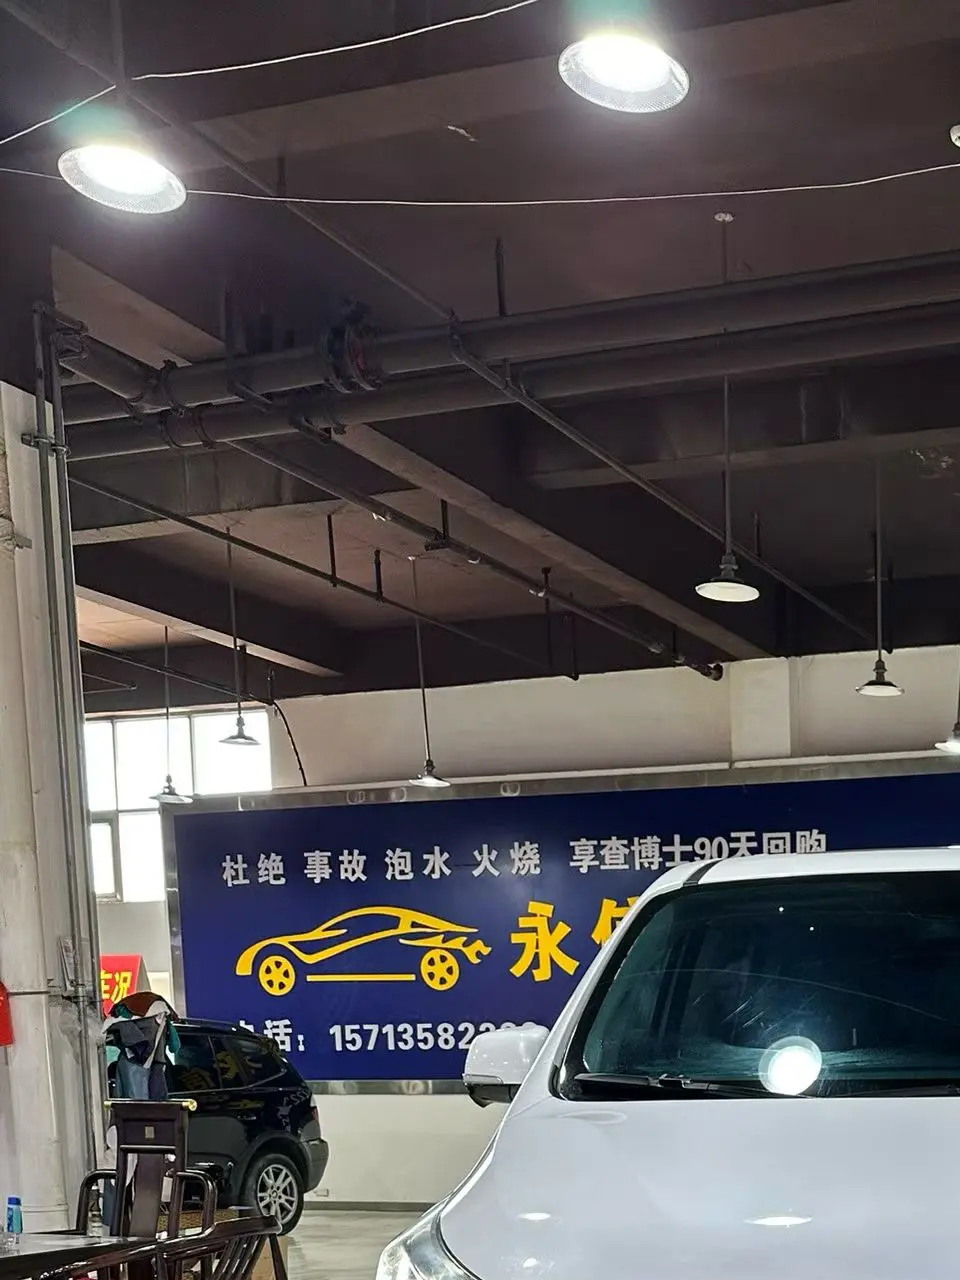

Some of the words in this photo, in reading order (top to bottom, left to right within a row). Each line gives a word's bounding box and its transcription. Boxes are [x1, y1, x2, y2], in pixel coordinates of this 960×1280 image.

[222, 851, 286, 887] 杜绝
[304, 848, 368, 884] 事故
[385, 845, 452, 880] 泡水
[471, 840, 542, 878] 火烧
[569, 827, 828, 874] 享查博士90天回购
[231, 1018, 305, 1052] 话：
[328, 1021, 538, 1052] 15713582
